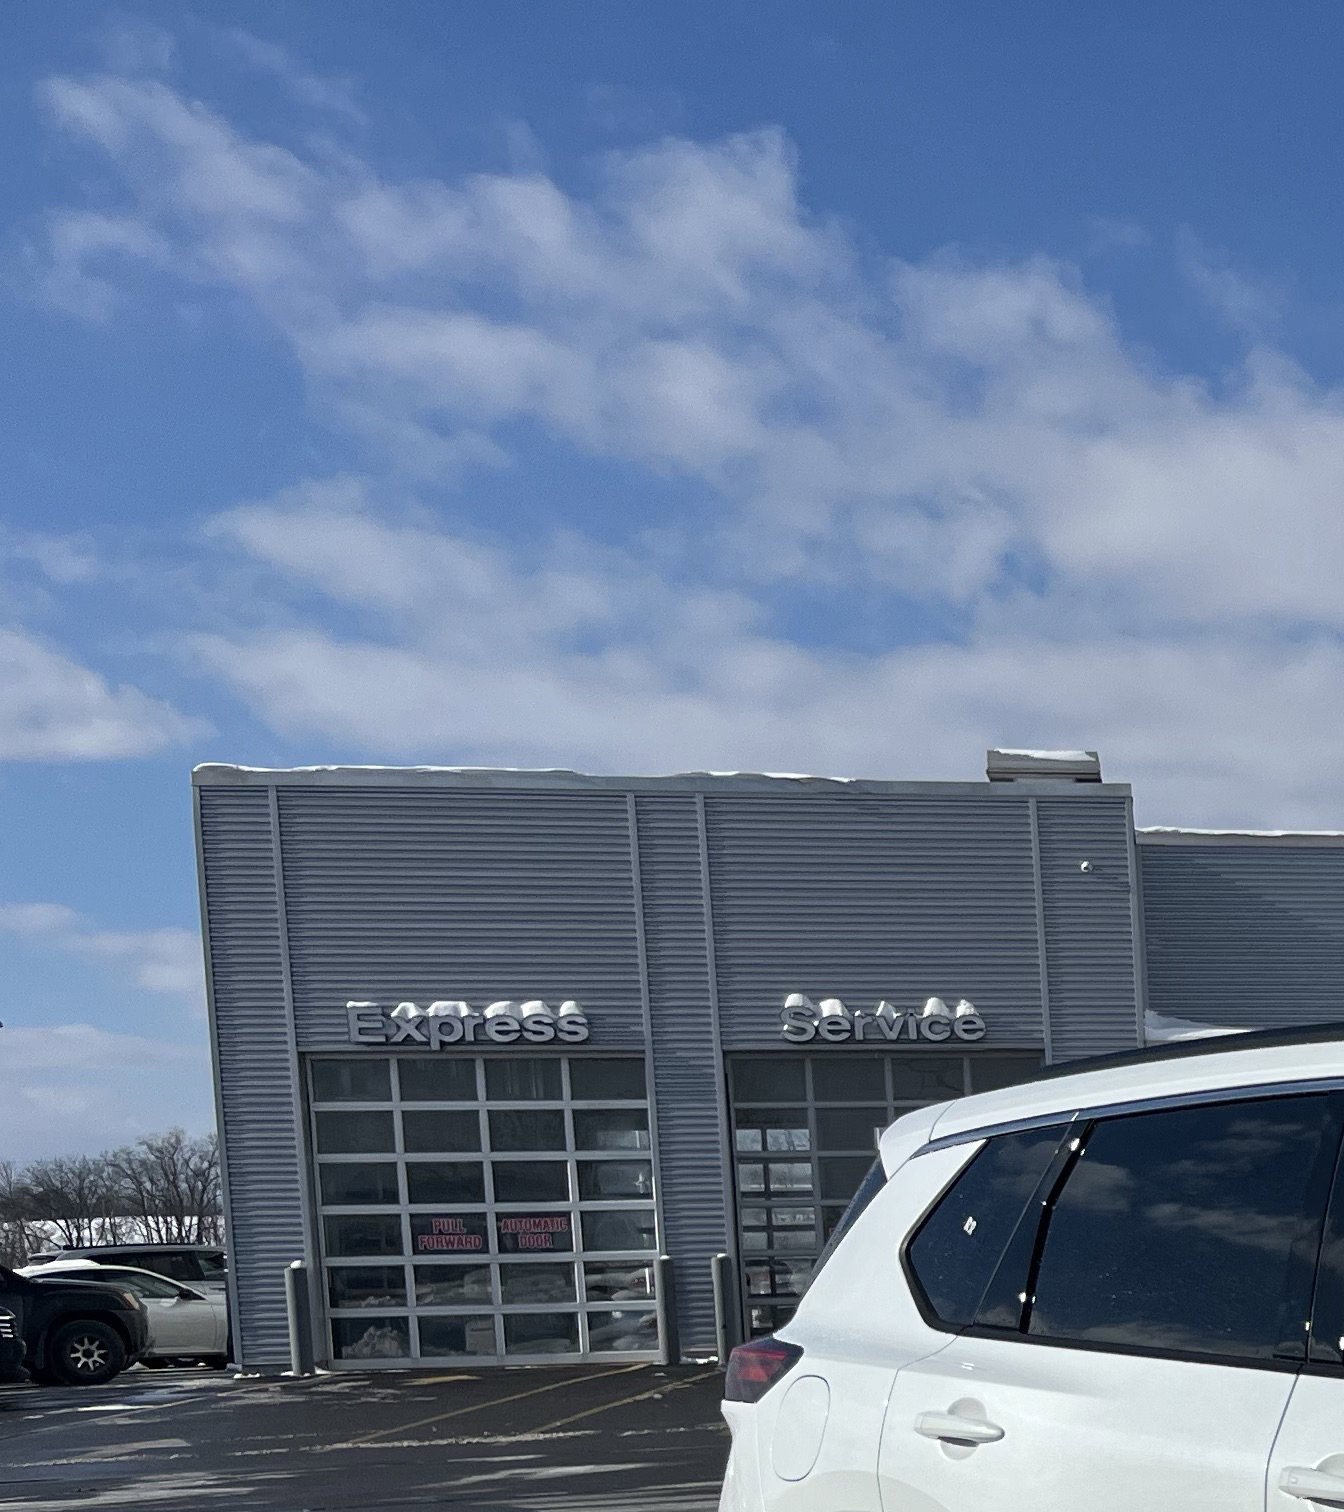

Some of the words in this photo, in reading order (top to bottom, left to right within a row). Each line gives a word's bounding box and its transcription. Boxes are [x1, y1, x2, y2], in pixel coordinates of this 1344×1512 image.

[346, 1003, 590, 1051] Express
[779, 1005, 987, 1042] Service
[432, 1218, 466, 1234] PULL
[501, 1216, 569, 1233] AUTOMATIC
[418, 1234, 483, 1250] FORWARD
[518, 1233, 553, 1249] DOOR
